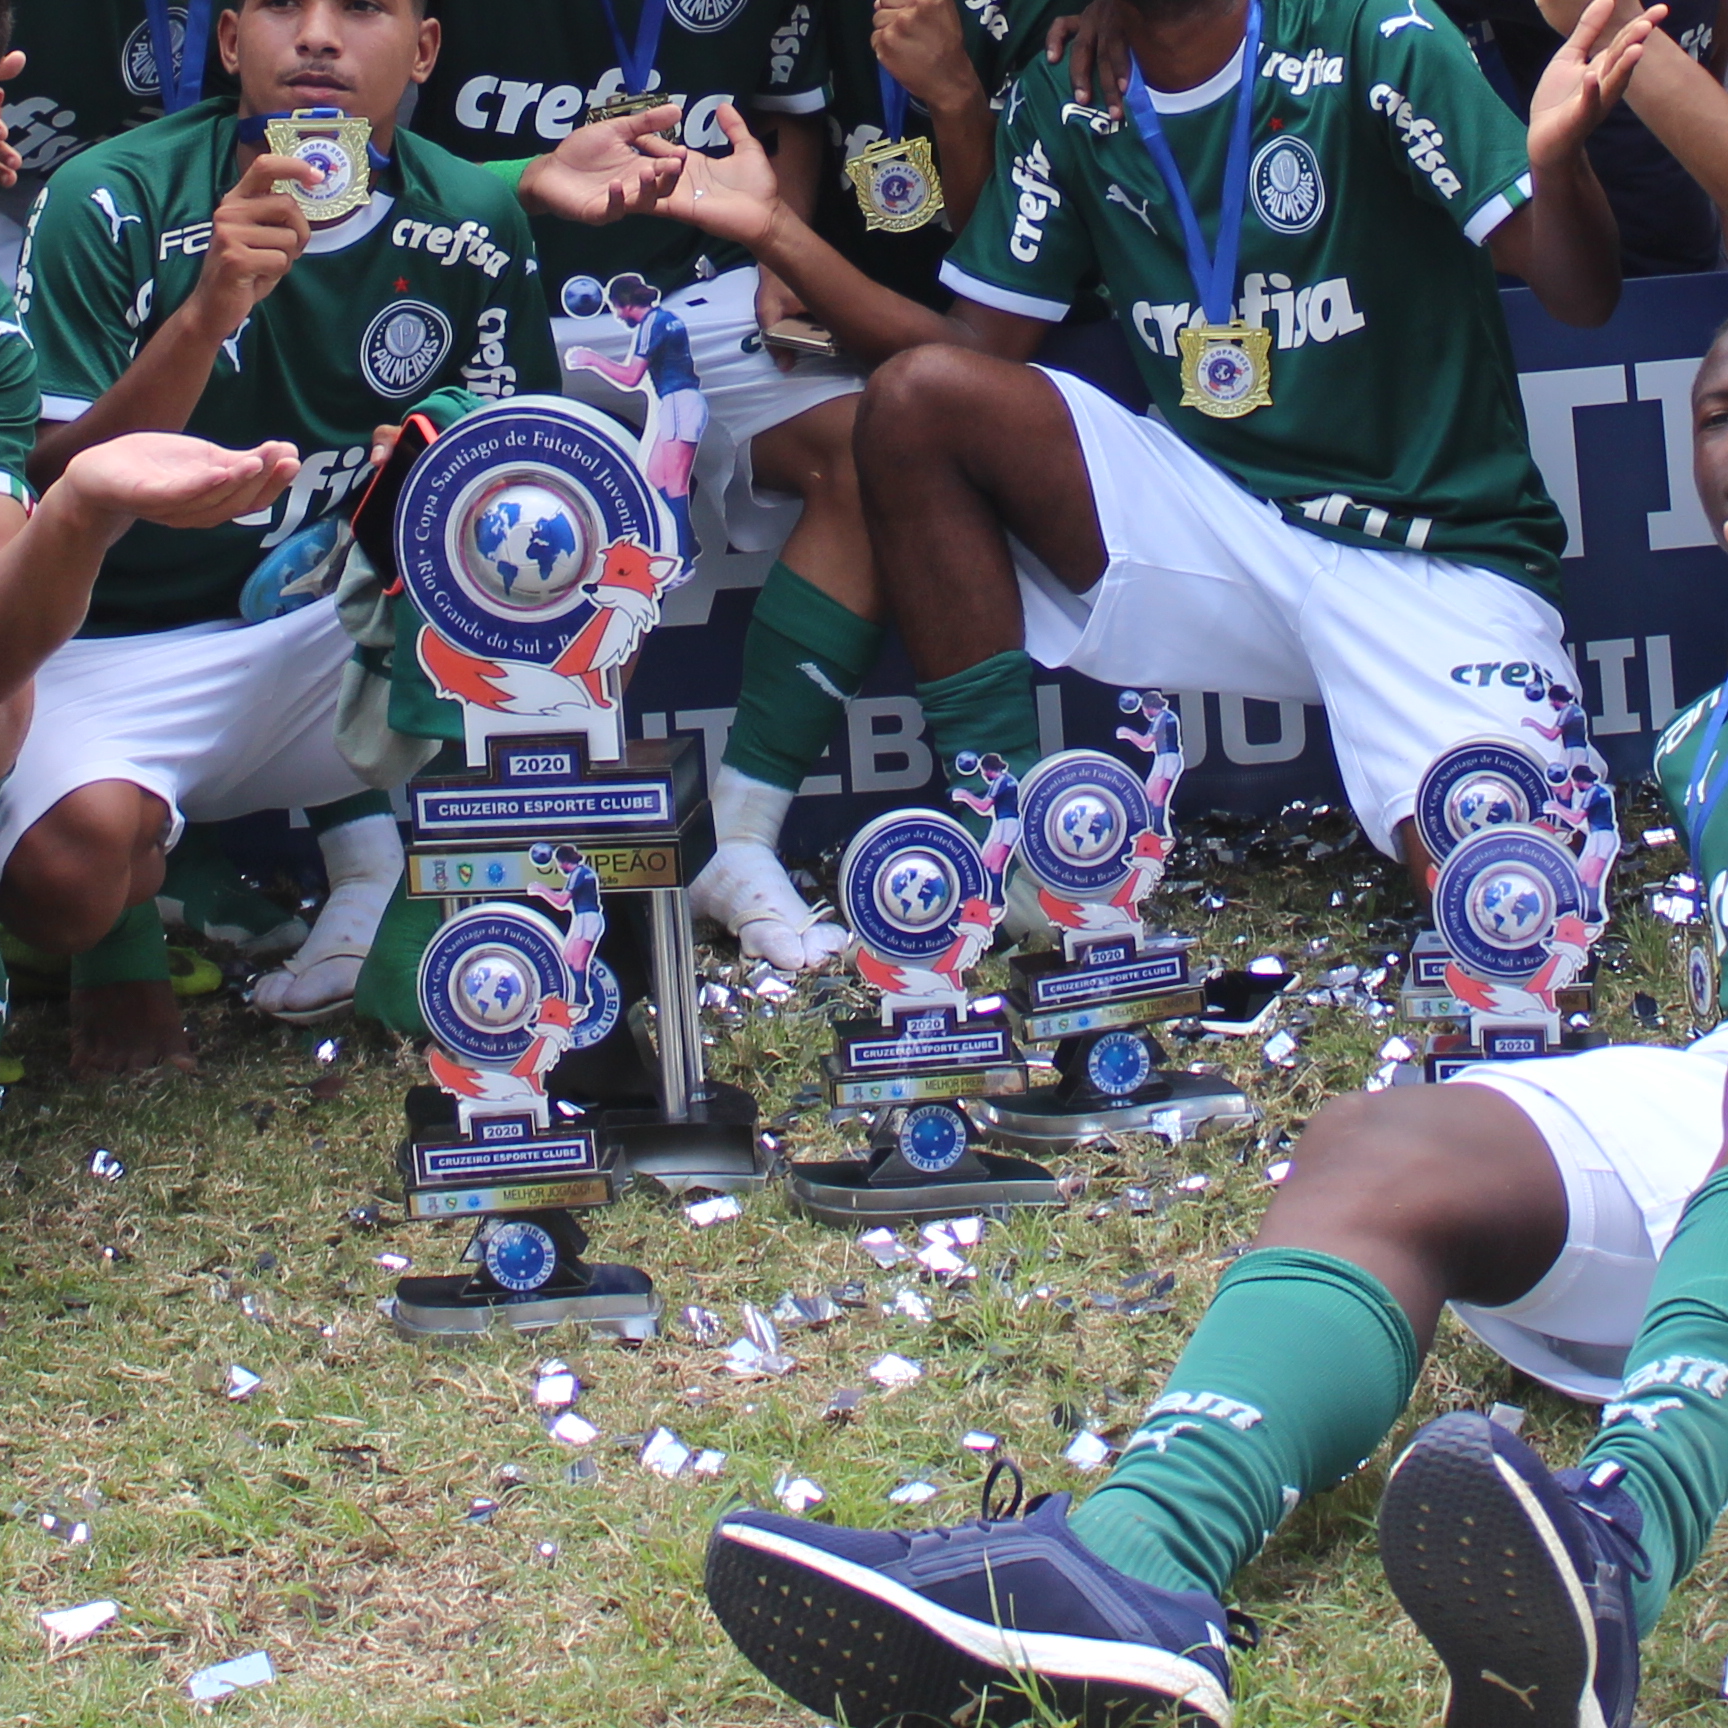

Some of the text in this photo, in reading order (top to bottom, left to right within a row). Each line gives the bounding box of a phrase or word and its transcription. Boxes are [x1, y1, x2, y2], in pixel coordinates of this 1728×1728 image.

[1369, 82, 1464, 201] crefisa
[302, 142, 347, 170] COPA 2020
[1261, 172, 1315, 221] PALMEIRAS
[392, 217, 512, 279] crefisa
[370, 338, 439, 388] PALMEIRAS
[1209, 349, 1232, 359] COPA
[415, 489, 440, 540] Copa
[429, 436, 502, 492] Santiago
[504, 430, 528, 449] de
[532, 429, 602, 470] Futebol
[594, 465, 638, 535] Juvenil
[417, 559, 541, 655] Rio Grande do Sul
[515, 757, 565, 773] 2020
[1480, 754, 1492, 764] de
[1078, 769, 1090, 780] de
[1091, 767, 1126, 791] Futebol
[438, 795, 654, 817] CRUZEIRO ESPORTE CLUBE
[912, 829, 925, 840] de
[927, 830, 963, 858] Futebol
[957, 854, 977, 891] Juvenil
[1098, 865, 1123, 883] Brasil
[899, 937, 916, 951] Sul
[924, 932, 952, 949] Brasil
[432, 955, 447, 984] Copa
[488, 925, 500, 935] de
[1092, 949, 1124, 963] 2020
[1049, 964, 1173, 994] CRUZEIRO ESPORTE CLUBE
[910, 1019, 941, 1031] 2020
[914, 1042, 960, 1055] ESPORTE
[961, 1039, 995, 1052] CLUBE
[1498, 1040, 1531, 1052] 2020
[925, 1078, 959, 1091] MELHOR
[487, 1125, 519, 1137] 2020
[438, 1147, 577, 1168] CRUZEIRO ESPORTE CLUBE
[503, 1188, 546, 1202] MELHOR
